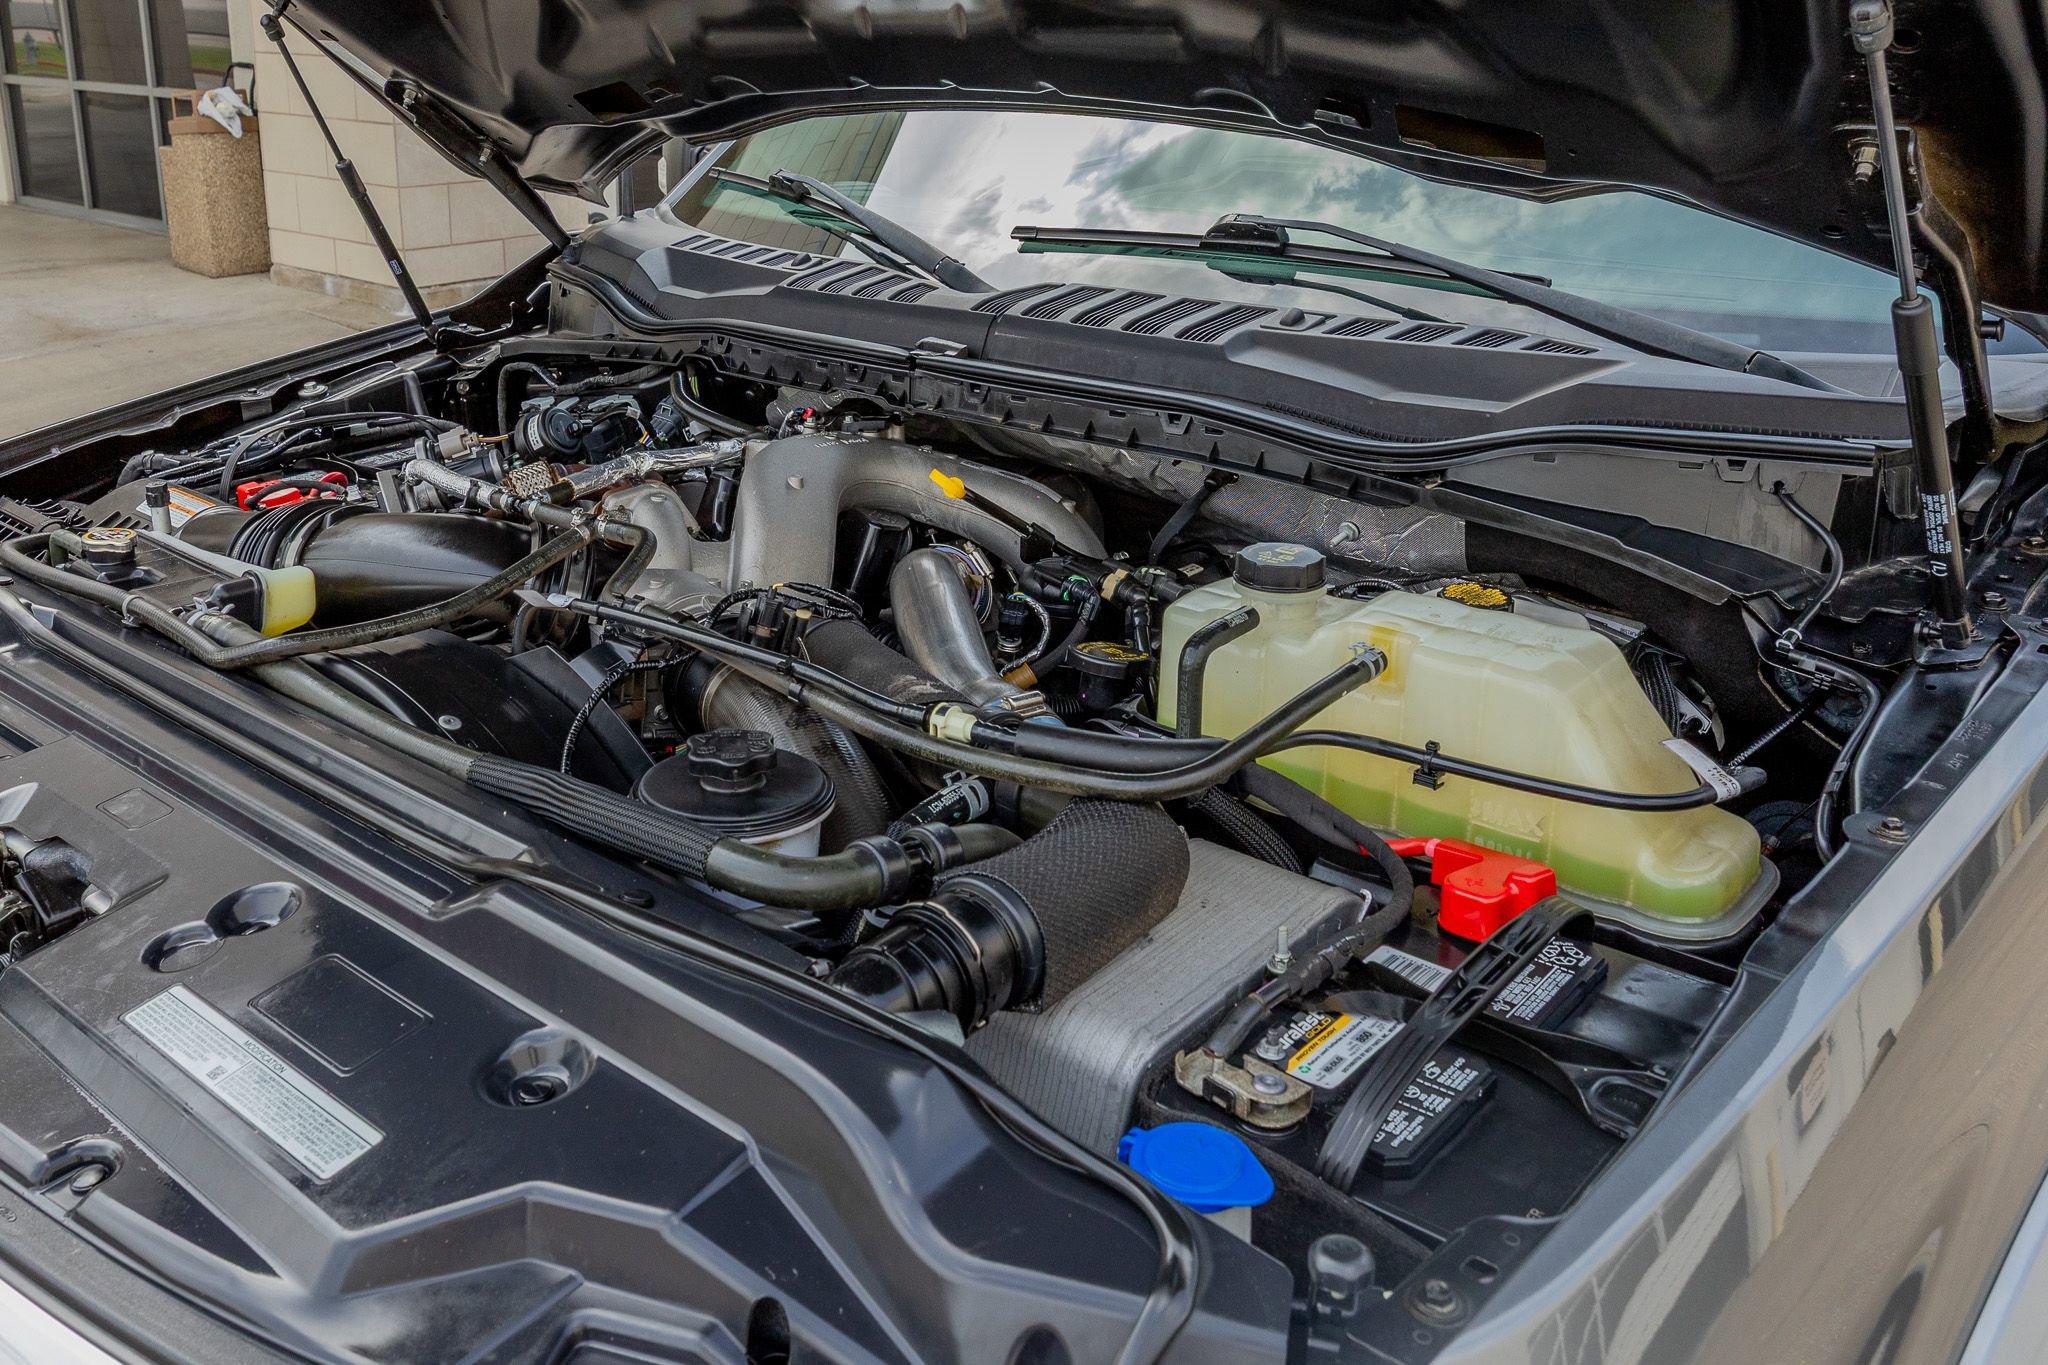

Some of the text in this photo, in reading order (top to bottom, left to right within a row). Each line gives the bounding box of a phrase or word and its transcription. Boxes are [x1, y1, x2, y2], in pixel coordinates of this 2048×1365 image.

[1304, 1017, 1332, 1039] GOLD
[1357, 1031, 1372, 1044] 850
[243, 1039, 288, 1075] MODIFICATION
[1295, 1042, 1319, 1062] PROVEN
[1317, 1027, 1337, 1044] TOUGH
